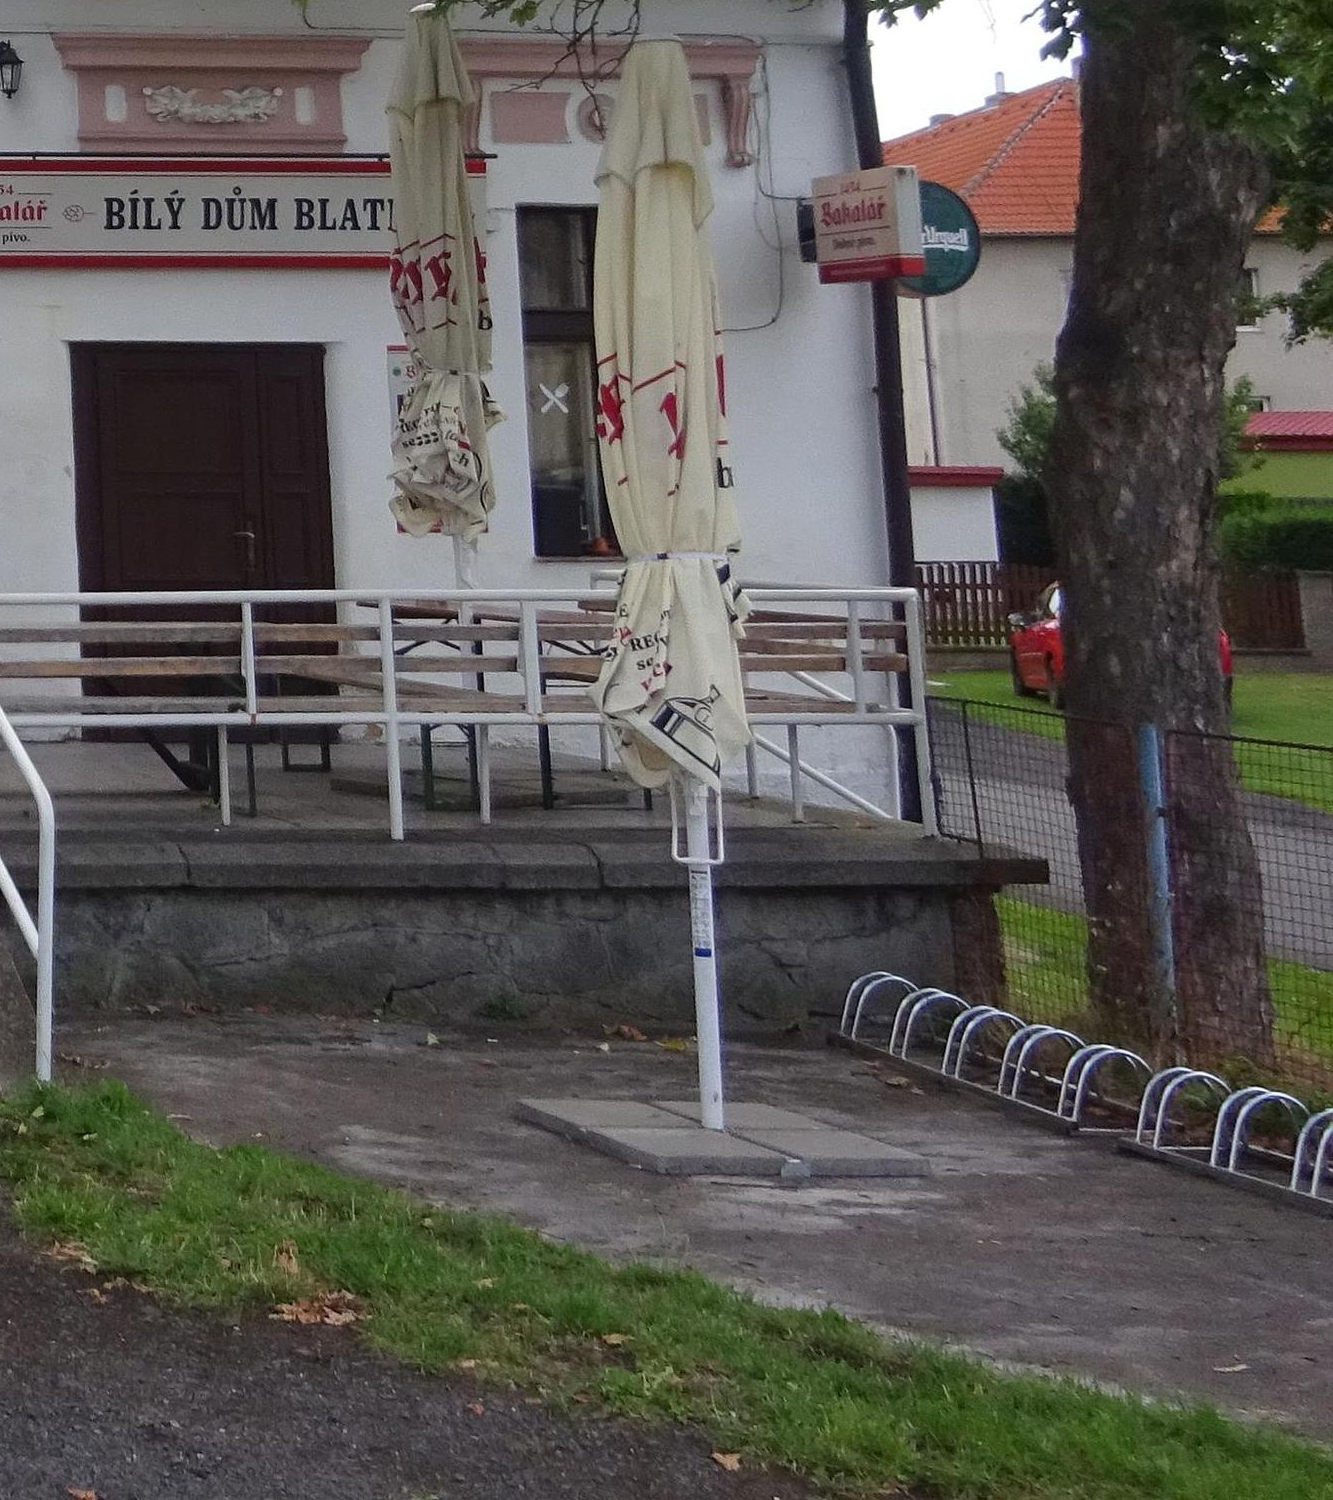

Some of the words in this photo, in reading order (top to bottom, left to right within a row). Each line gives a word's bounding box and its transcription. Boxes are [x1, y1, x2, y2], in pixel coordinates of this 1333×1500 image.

[103, 188, 186, 230] BÍLÝ
[201, 185, 278, 231] DŮM
[294, 198, 397, 232] BLAT
